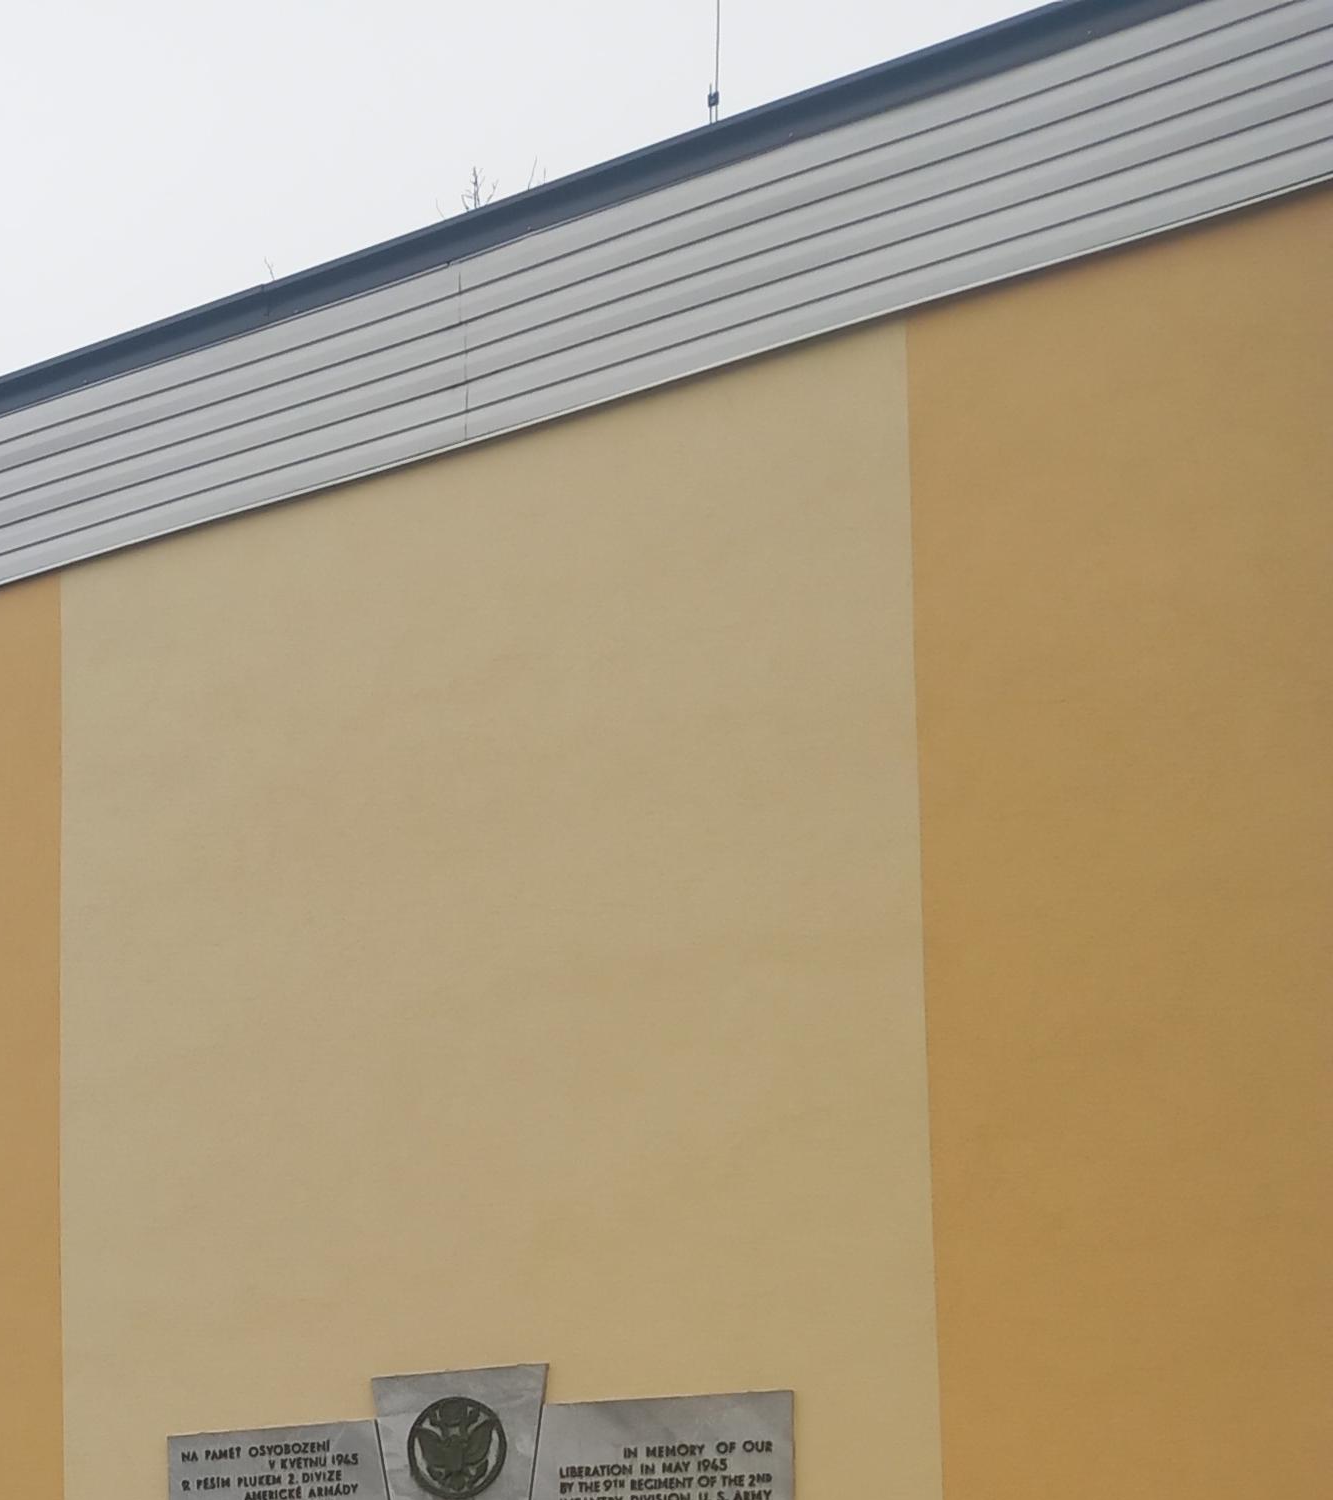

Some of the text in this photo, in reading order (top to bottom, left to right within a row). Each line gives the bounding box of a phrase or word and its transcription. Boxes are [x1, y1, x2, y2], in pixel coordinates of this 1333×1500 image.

[181, 1451, 199, 1463] NA
[248, 1439, 331, 1459] OSVOBOZENÍ
[623, 1440, 773, 1459] IN MEMORY OF OUR
[268, 1459, 276, 1470] V
[332, 1453, 359, 1466] 1945
[559, 1458, 728, 1479] LIBERATION IN MAY 1945
[237, 1474, 282, 1488] PLUKEM
[288, 1473, 299, 1485] 2.
[302, 1469, 342, 1483] DIVIZE
[559, 1473, 773, 1494] BY THE 9TH REGIMENT OF THE 2ND
[308, 1483, 359, 1498] ARMÁDY
